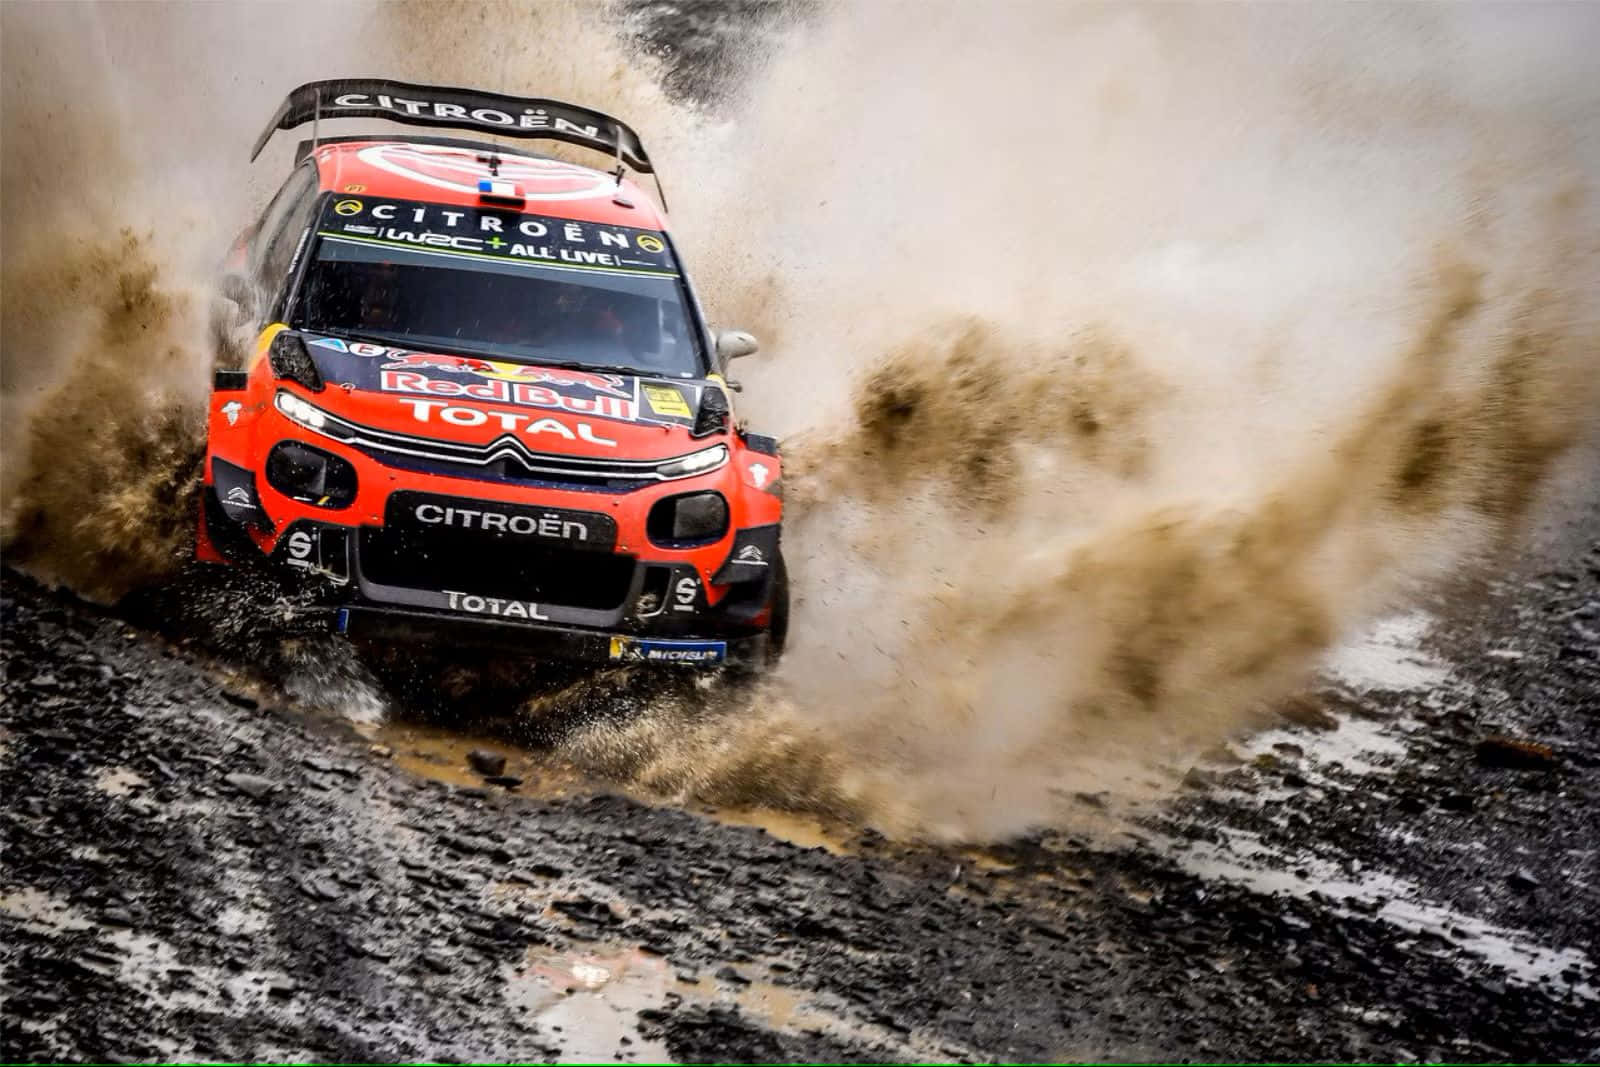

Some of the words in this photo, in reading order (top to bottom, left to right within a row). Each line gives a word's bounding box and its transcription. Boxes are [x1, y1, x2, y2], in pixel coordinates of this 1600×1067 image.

[334, 94, 599, 138] CITROËN
[371, 204, 630, 248] CITROËN
[510, 244, 557, 260] ALL
[561, 249, 614, 265] LIVE
[380, 371, 510, 401] Red
[513, 383, 636, 421] Bull
[400, 399, 617, 447] TOTAL
[442, 590, 549, 620] TOTAL
